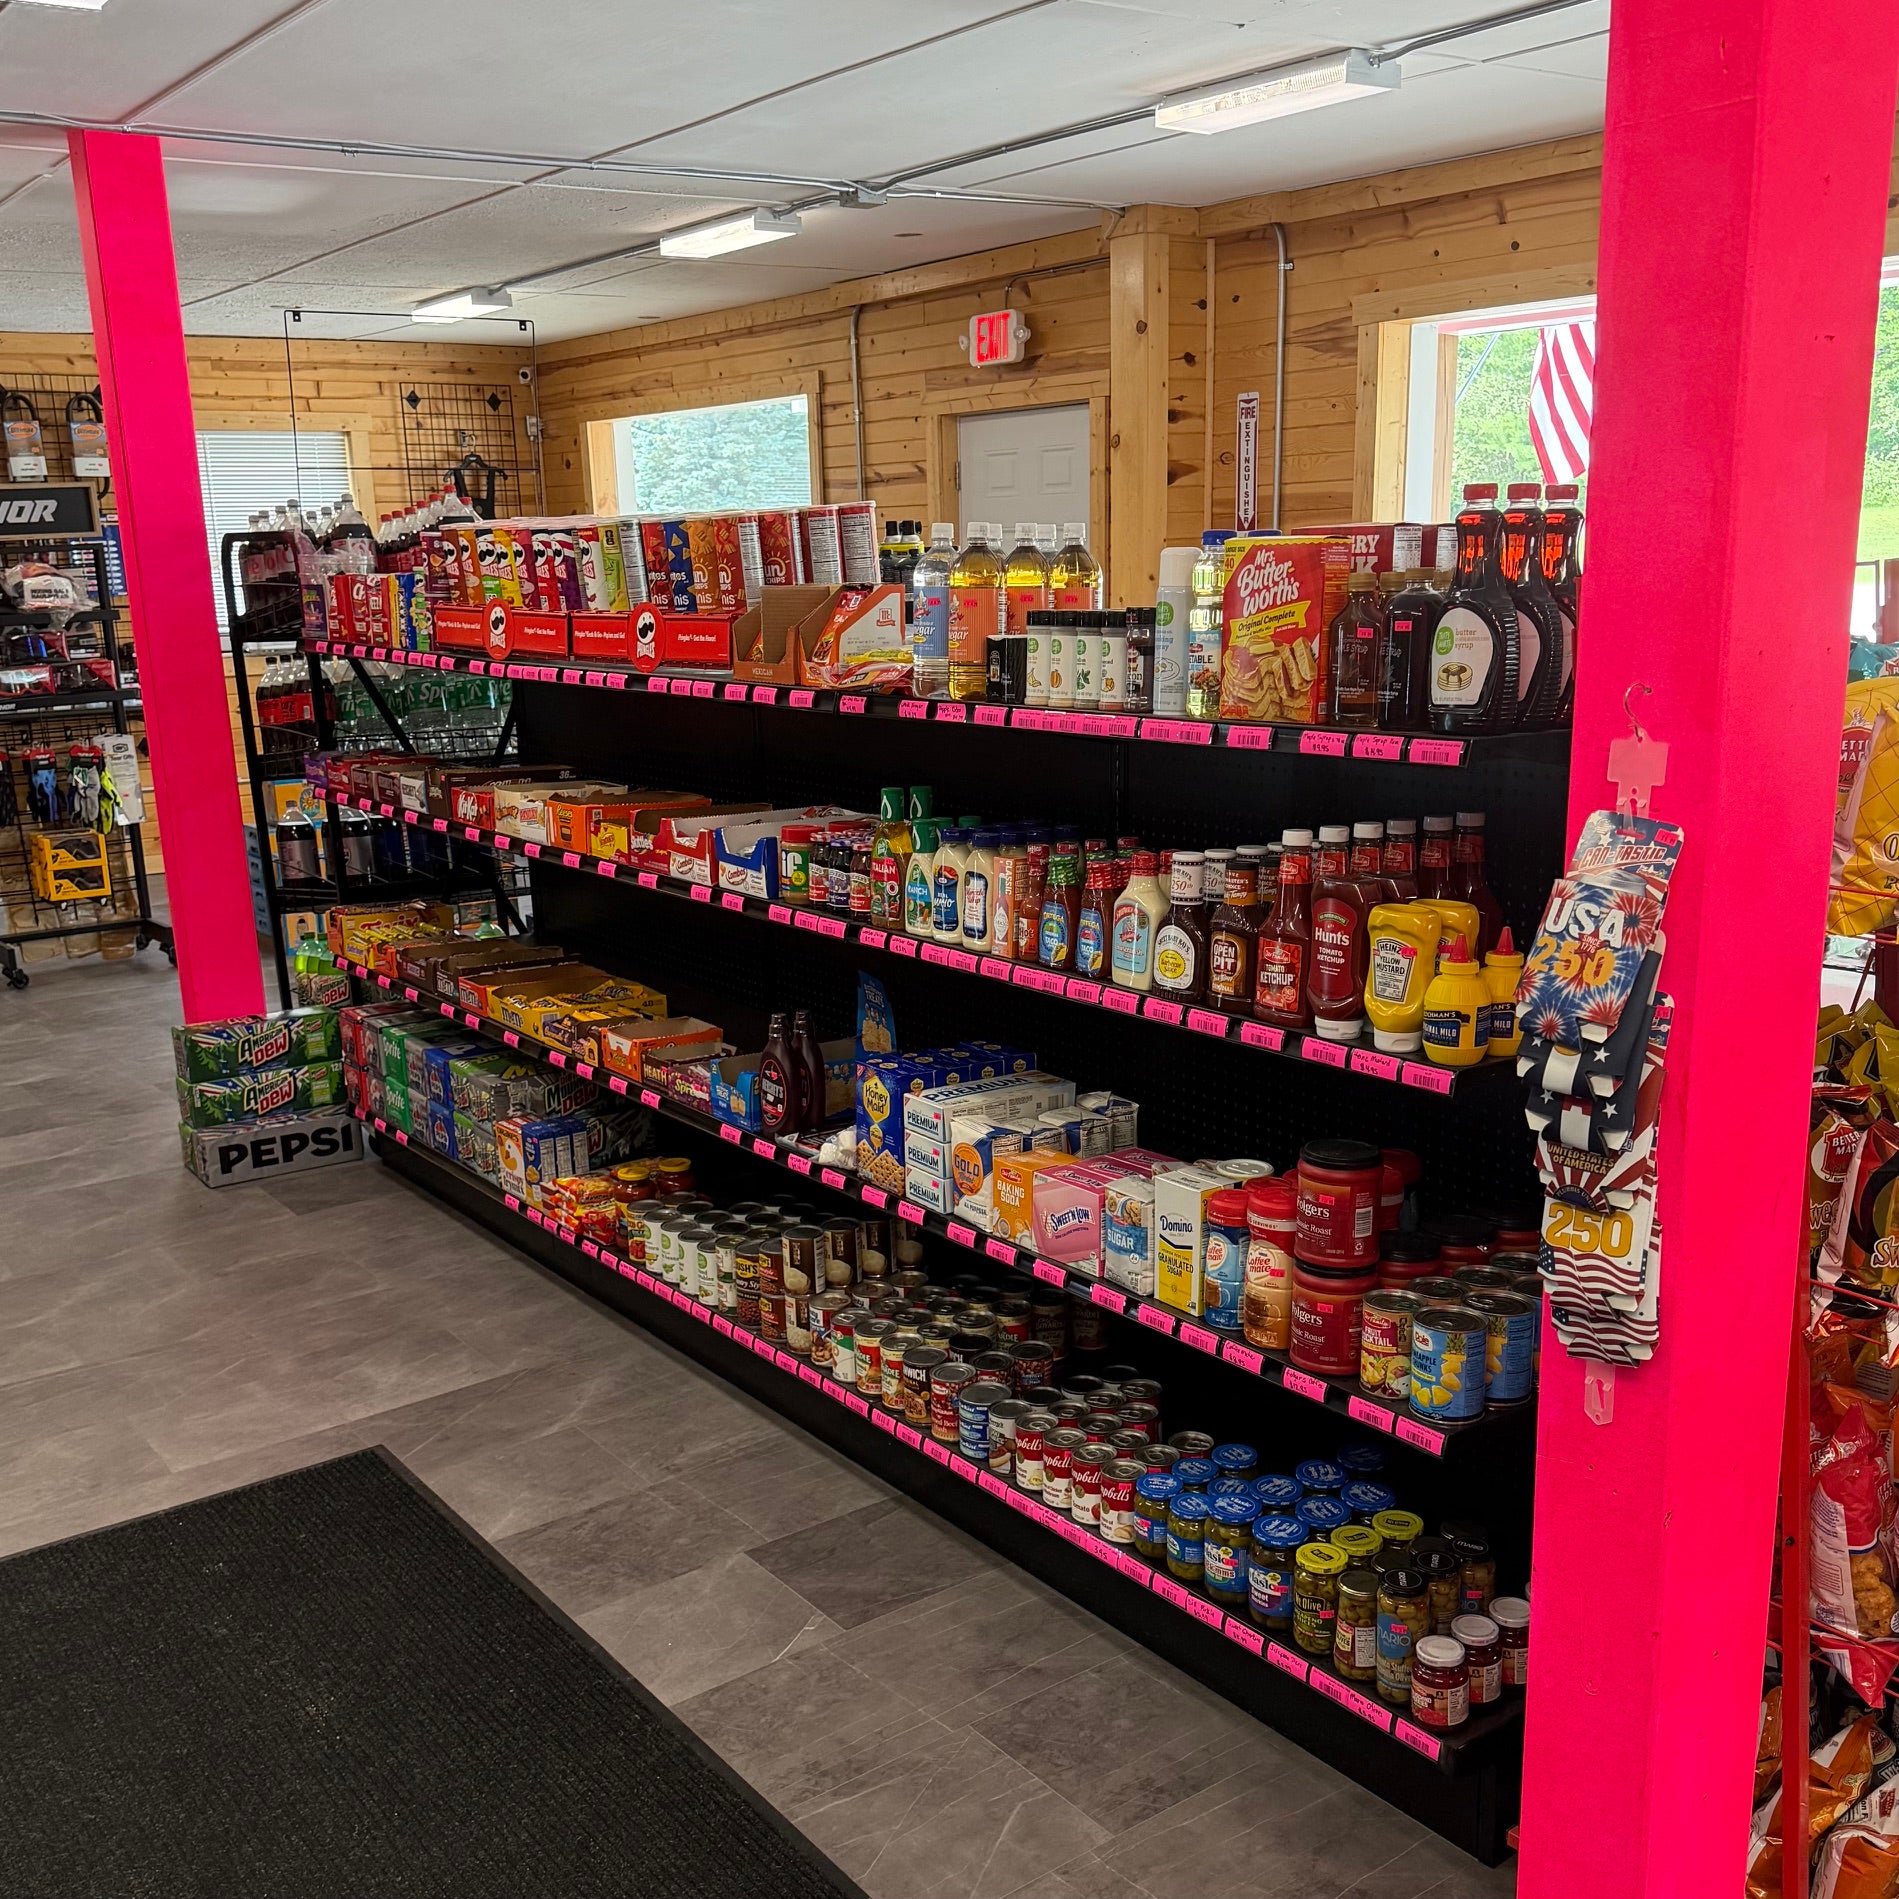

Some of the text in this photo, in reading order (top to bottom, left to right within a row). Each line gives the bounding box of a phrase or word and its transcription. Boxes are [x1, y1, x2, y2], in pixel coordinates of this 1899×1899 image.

[976, 312, 1010, 362] EXIT
[1240, 406, 1256, 420] FIRE
[1243, 421, 1252, 524] EXTINGUISHER
[1224, 558, 1235, 569] 40
[1254, 549, 1275, 567] Mrs.
[765, 563, 780, 577] un
[1237, 560, 1296, 598] Butter-
[1242, 577, 1300, 618] worth's
[1237, 610, 1296, 632] Original Complete
[1455, 628, 1477, 636] butter
[1455, 642, 1474, 650] syrup
[1189, 654, 1211, 664] ETABLE
[782, 851, 802, 878] if
[727, 867, 746, 881] Combos
[1005, 860, 1013, 895] CLASSIC
[1545, 897, 1625, 949] USA
[1315, 927, 1350, 946] Hunt's
[1582, 934, 1601, 946] SINCE
[1213, 944, 1235, 958] OPEN
[1318, 946, 1343, 957] TOMATO
[1581, 941, 1597, 954] 1776
[1213, 957, 1235, 970] PIT
[1317, 954, 1345, 964] KETCHUP
[1379, 955, 1401, 966] YELLOW
[1530, 936, 1616, 986] 250
[1265, 963, 1285, 973] TOMATO
[1376, 963, 1405, 975] MUSTARD
[1260, 971, 1294, 985] KETCHUP
[1440, 1025, 1457, 1037] MILD
[643, 1063, 668, 1086] HEATH
[675, 1079, 695, 1096] Spre
[865, 1084, 889, 1105] Honey
[924, 1076, 1031, 1101] PREMIUM
[866, 1100, 885, 1115] Maid
[907, 1111, 939, 1132] PREMIUM
[1832, 1131, 1861, 1147] BETTER
[218, 1123, 354, 1175] PEPSI
[1548, 1144, 1615, 1168] UNITED STATES
[1836, 1144, 1857, 1156] MAD
[908, 1148, 939, 1169] PREMIUM
[954, 1154, 980, 1177] GOLD
[1552, 1155, 1607, 1175] OF AMERICA
[909, 1182, 940, 1205] PREMIUM
[997, 1181, 1025, 1199] BAKING
[1000, 1192, 1020, 1207] SODA
[1076, 1207, 1091, 1222] LOW
[1160, 1215, 1193, 1233] Domino
[1310, 1224, 1333, 1236] Roast
[1546, 1201, 1634, 1258] 250
[1107, 1229, 1134, 1250] SUGAR
[736, 1264, 758, 1275] USH'S
[1158, 1252, 1194, 1274] GRANULATED
[1249, 1263, 1271, 1274] mate
[1166, 1265, 1183, 1278] SUGAR
[1304, 1331, 1325, 1343] Roast
[1364, 1325, 1382, 1338] FRUIT
[1415, 1334, 1430, 1347] Dole
[1302, 1598, 1321, 1610] Olive
